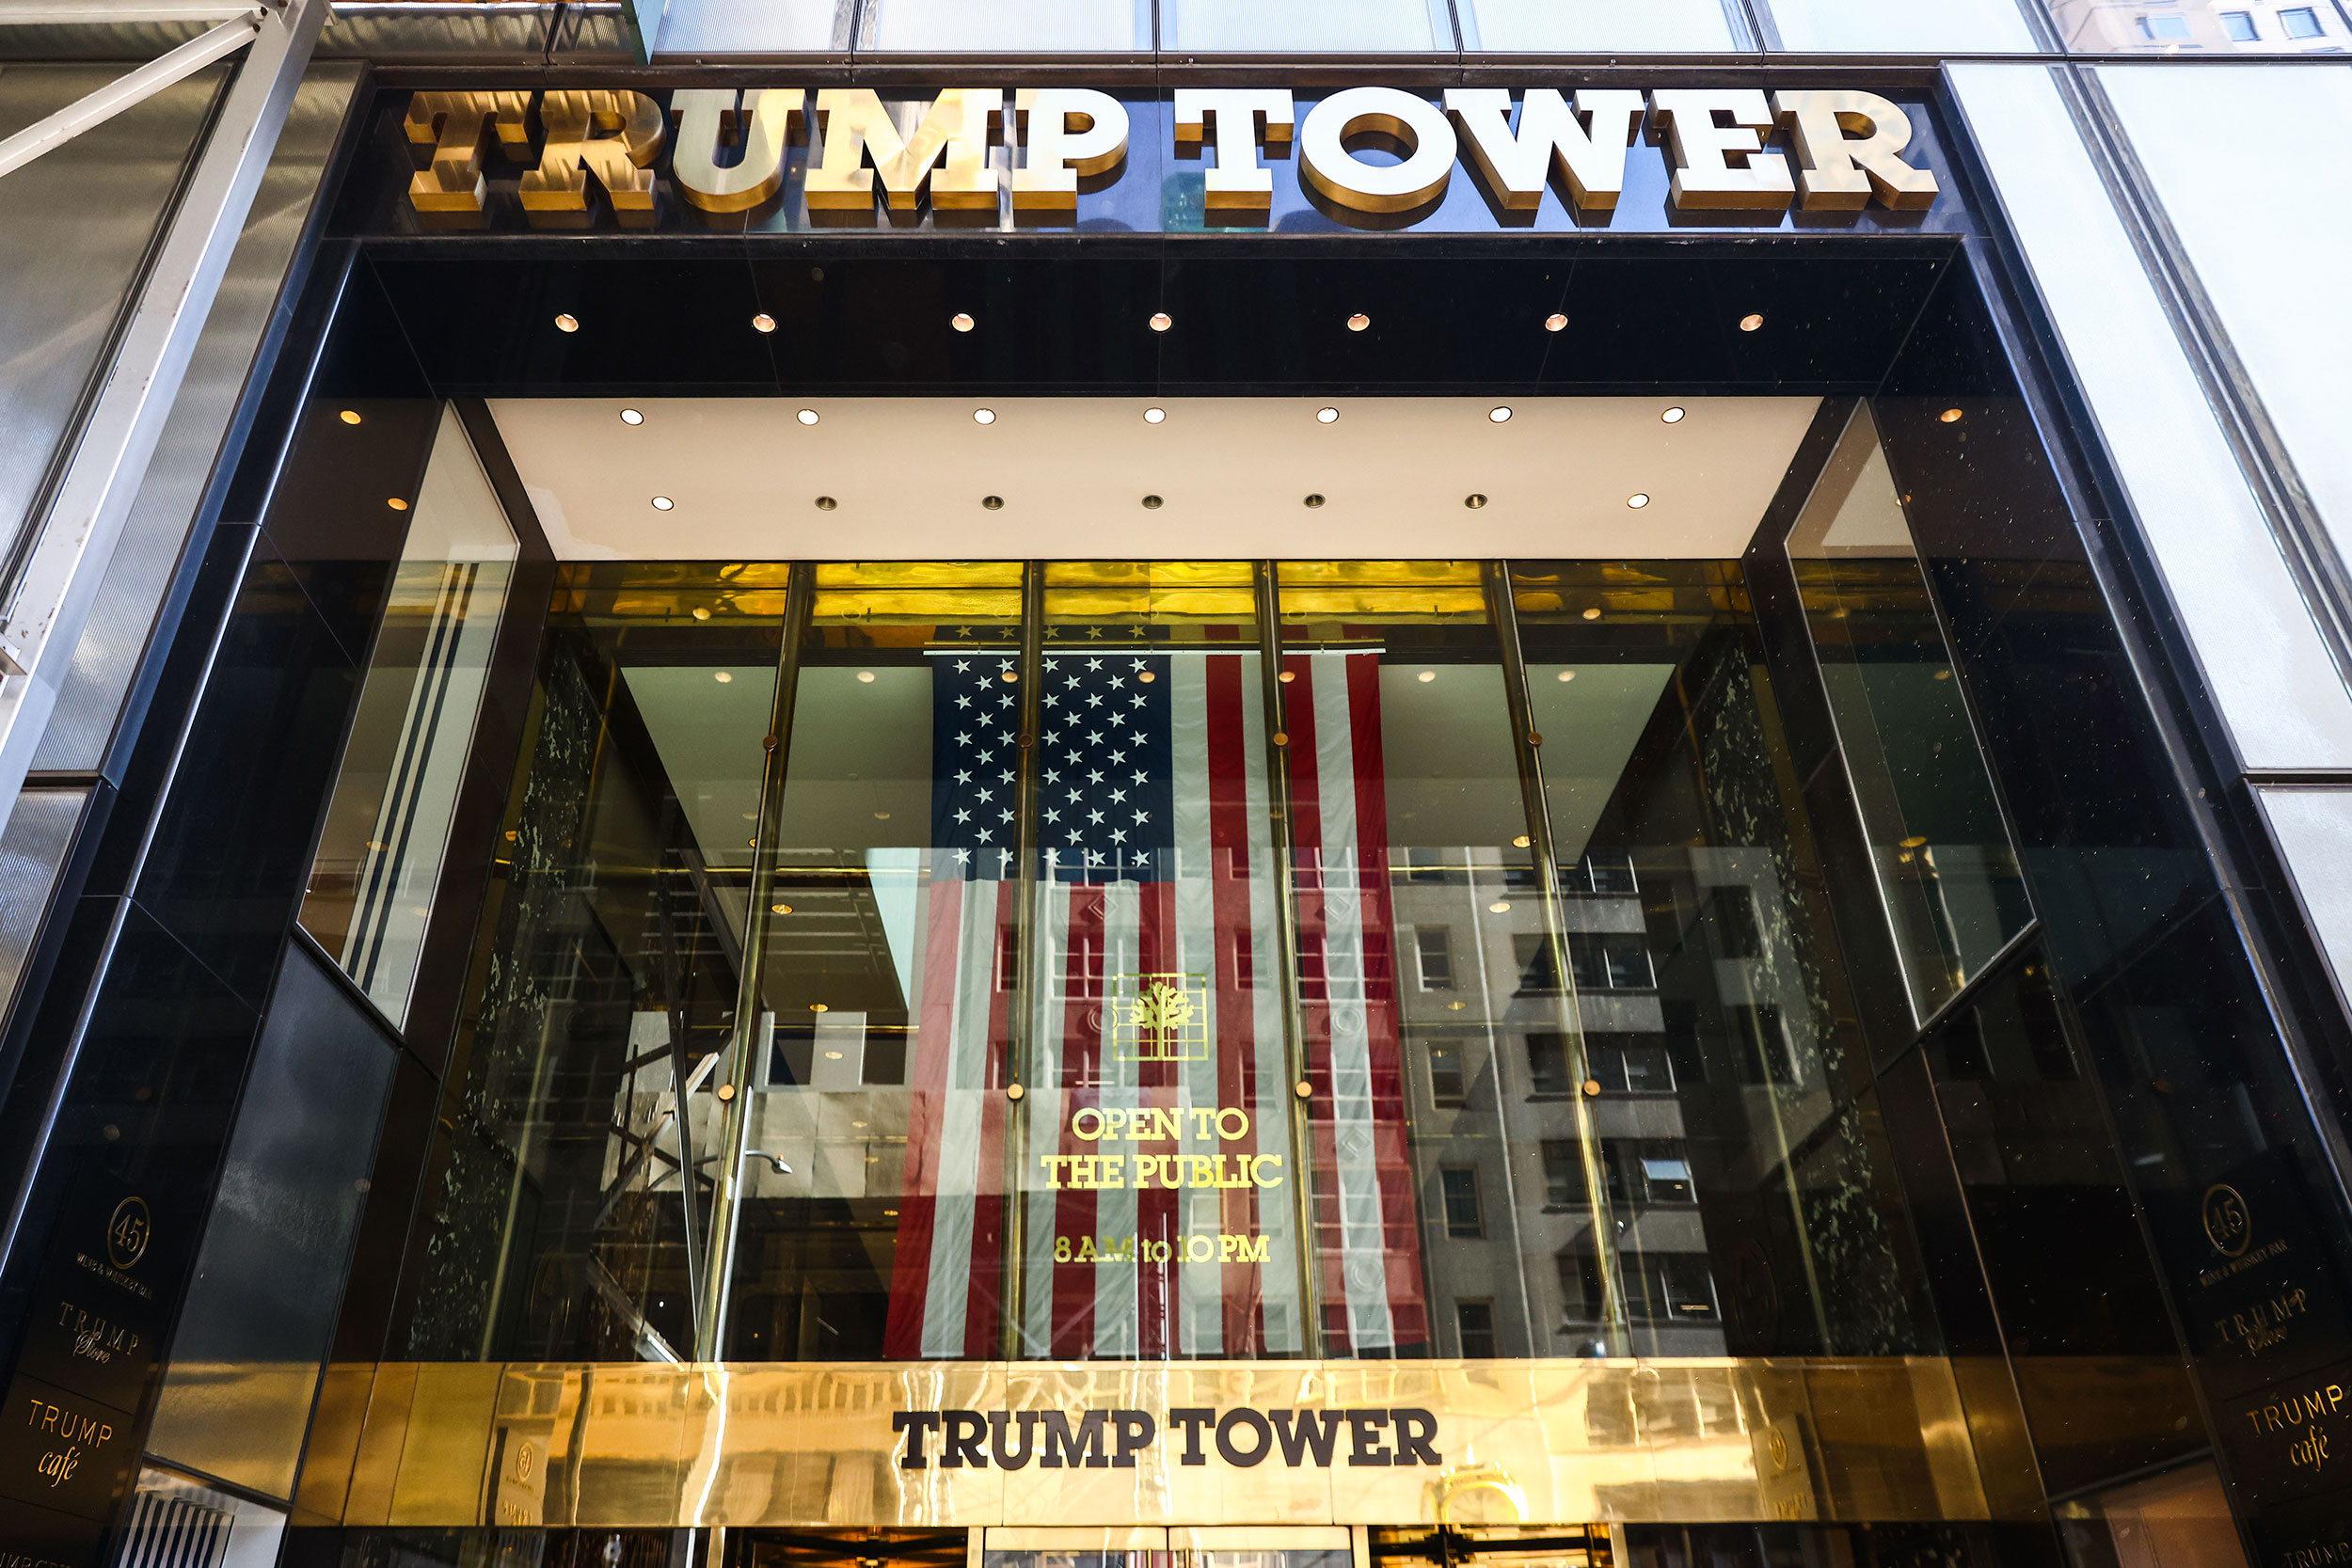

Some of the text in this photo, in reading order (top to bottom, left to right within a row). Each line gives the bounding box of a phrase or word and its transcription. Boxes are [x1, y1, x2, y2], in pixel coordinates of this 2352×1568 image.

[405, 86, 1939, 214] TRUMP TOWER
[1072, 1107, 1249, 1141] OPEN TO
[1041, 1153, 1284, 1189] THE PUBLIC
[115, 1213, 145, 1252] 45
[1054, 1234, 1271, 1263] 8 AM to 10 PM
[58, 1301, 140, 1355] TRUMP
[2214, 1288, 2308, 1343] TRUMP
[28, 1399, 113, 1449] TRUMP
[2246, 1384, 2344, 1436] TRUMP
[892, 1407, 1442, 1470] TRUMP TOWER
[2290, 1424, 2330, 1471] café
[38, 1445, 80, 1487] café
[2282, 1542, 2350, 1568] TRUMP
